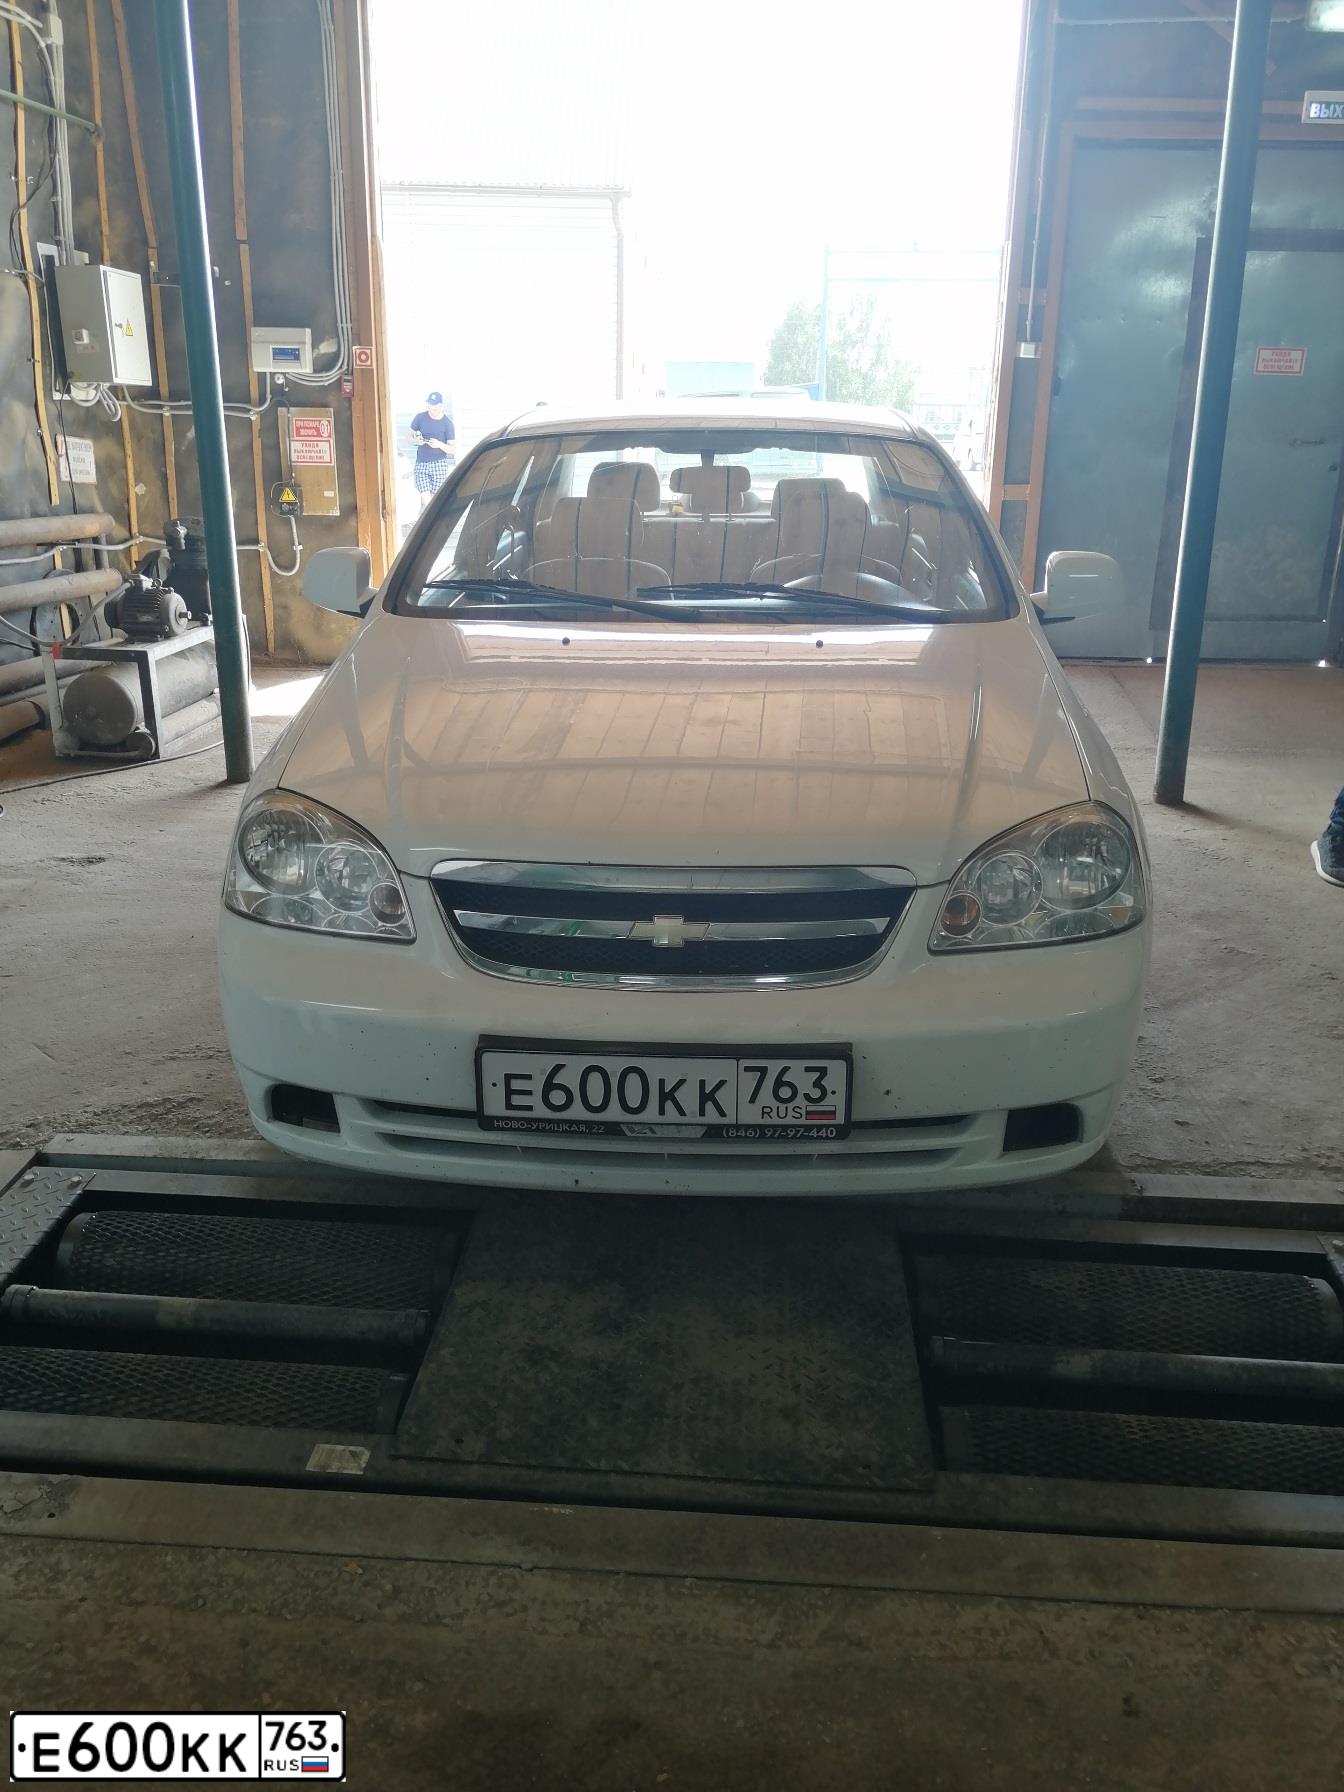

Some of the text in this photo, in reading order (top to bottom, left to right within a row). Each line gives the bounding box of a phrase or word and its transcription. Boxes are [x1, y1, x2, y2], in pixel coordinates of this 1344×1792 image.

[743, 1066, 828, 1105] 763
[761, 1105, 803, 1120] RUS
[494, 1119, 605, 1134] НОВО-УРИЦКАЯ, 22
[722, 1127, 836, 1138] (846) 97-97-440
